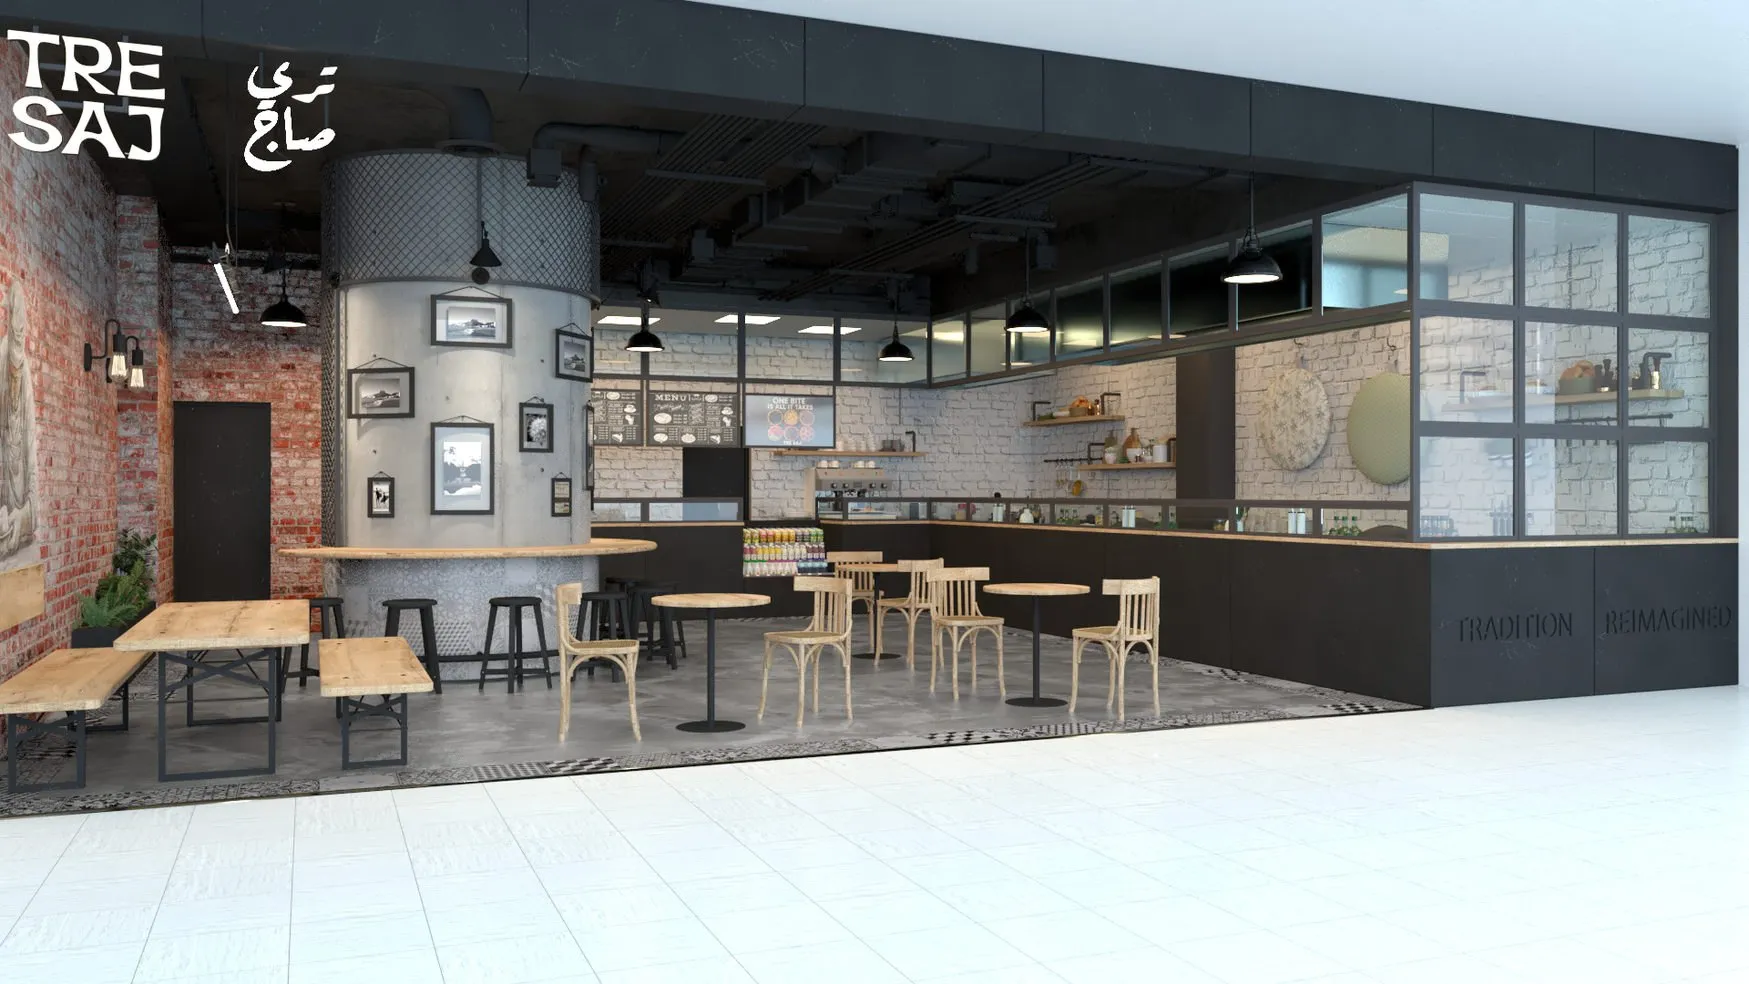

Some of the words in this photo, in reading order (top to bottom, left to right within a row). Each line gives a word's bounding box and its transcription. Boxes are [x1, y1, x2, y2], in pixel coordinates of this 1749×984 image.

[7, 29, 165, 100] TRE
[247, 62, 338, 110] تري
[8, 95, 164, 161] SAJ
[244, 106, 336, 172] صاج
[654, 393, 687, 402] MENU
[1459, 612, 1573, 642] TRADITION
[1605, 605, 1733, 635] REIMAGINED
